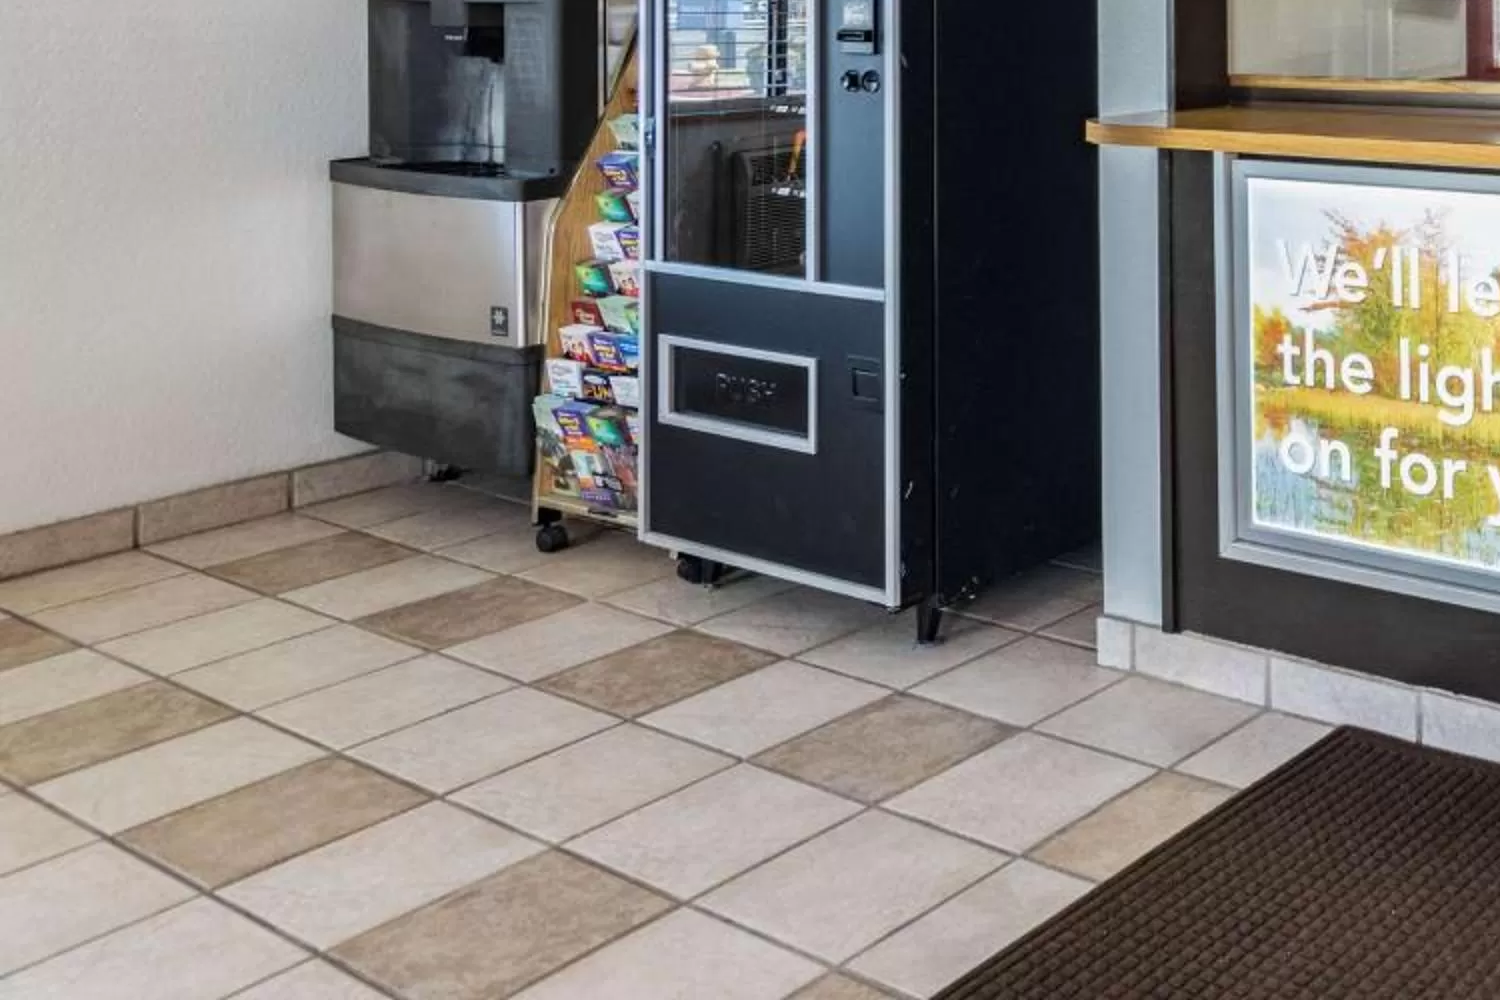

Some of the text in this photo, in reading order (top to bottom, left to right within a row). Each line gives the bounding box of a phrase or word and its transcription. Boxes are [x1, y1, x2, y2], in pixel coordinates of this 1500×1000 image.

[1277, 238, 1419, 311] We'll
[1277, 334, 1374, 394] the
[1278, 429, 1352, 484] on
[1374, 427, 1469, 500] for
